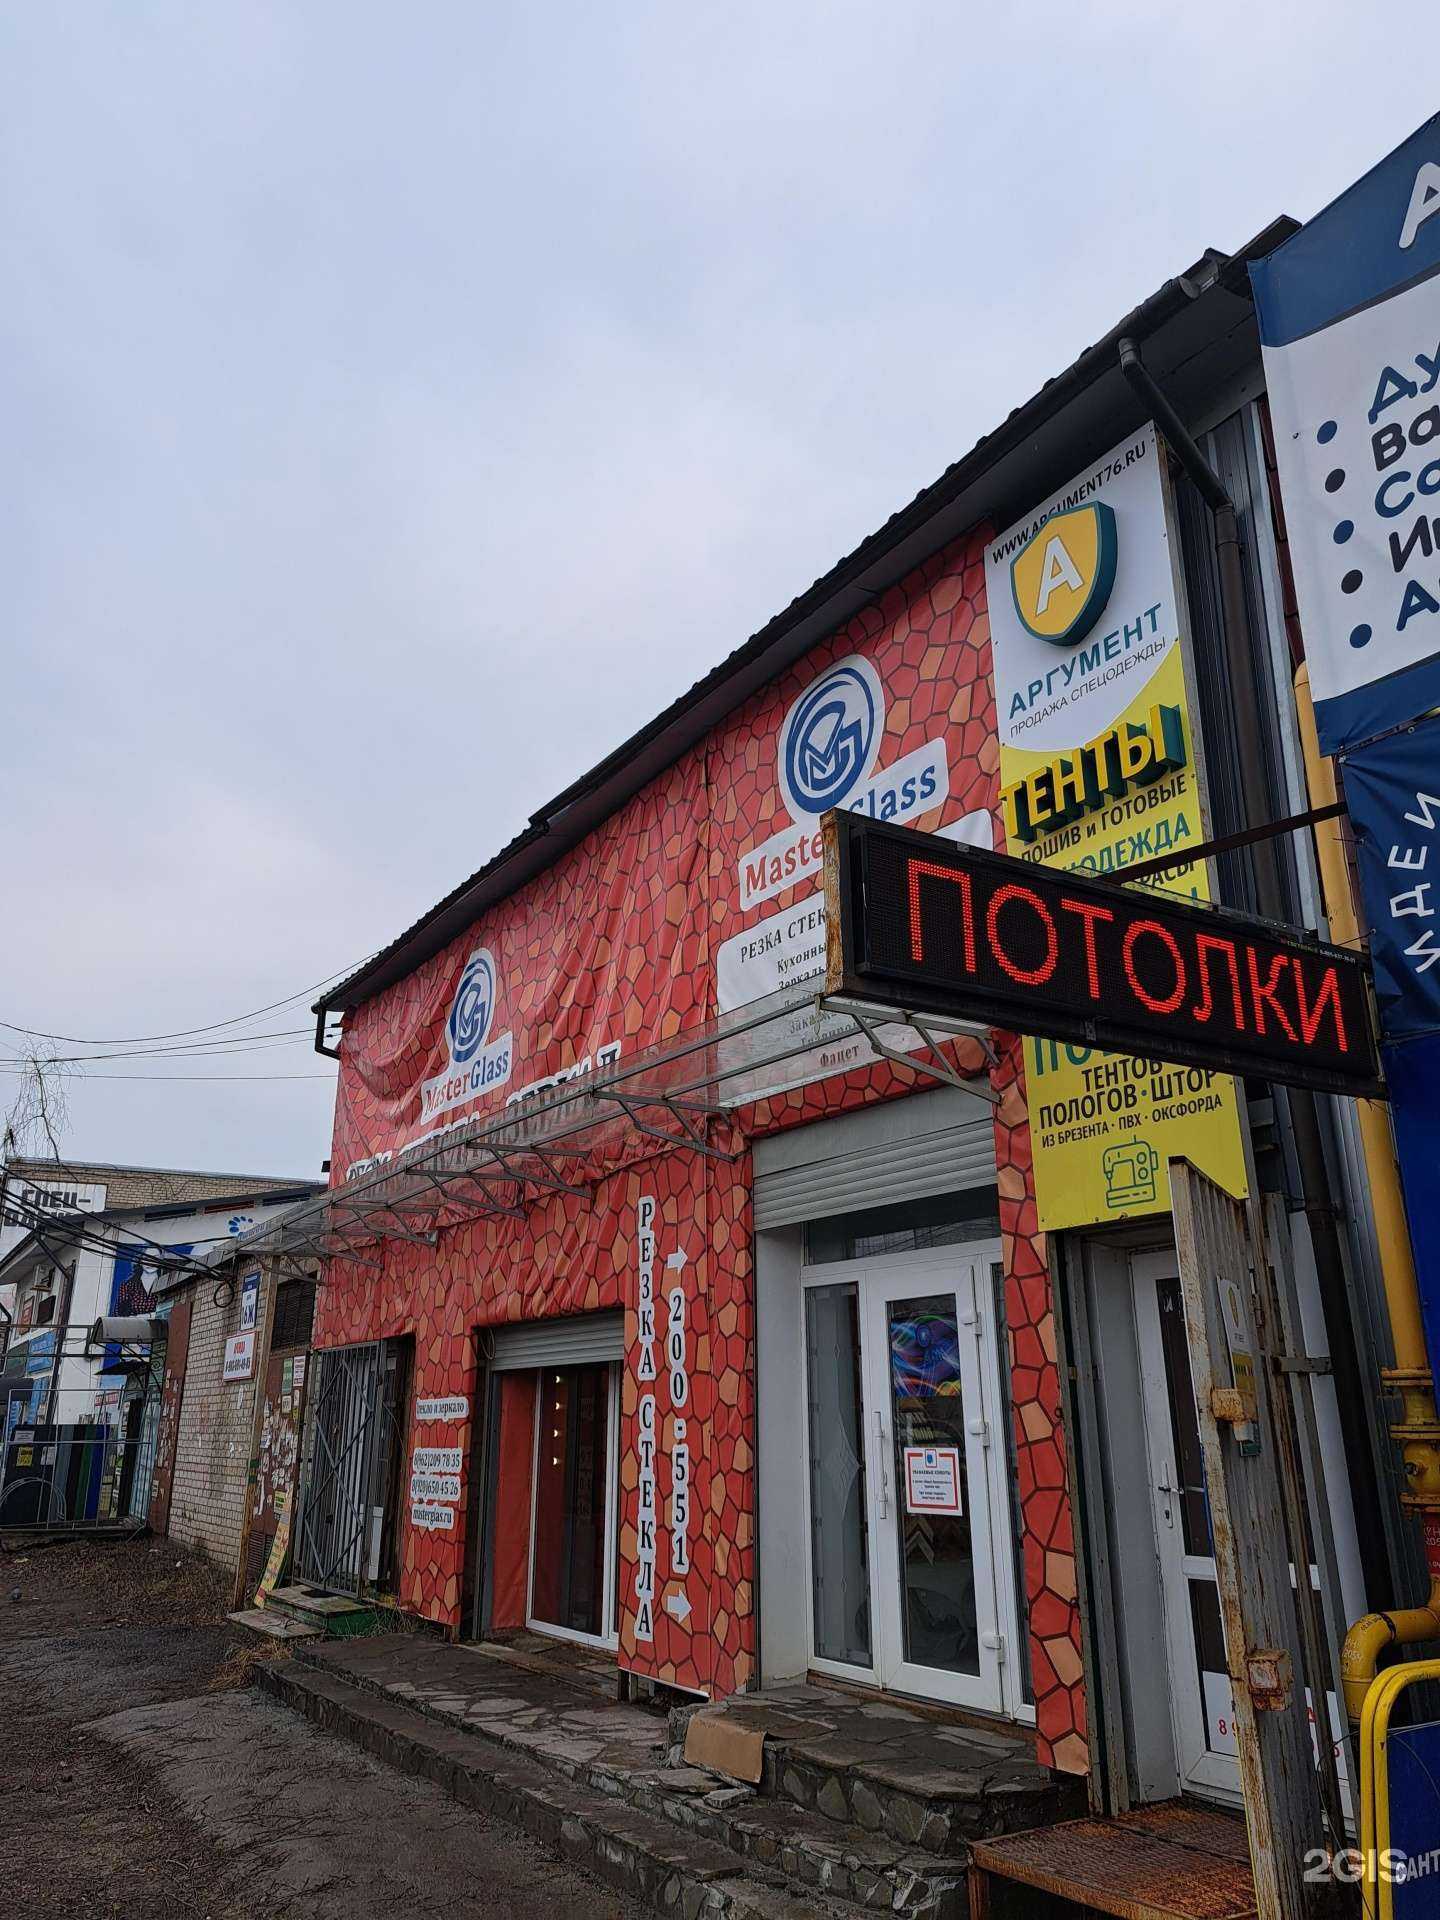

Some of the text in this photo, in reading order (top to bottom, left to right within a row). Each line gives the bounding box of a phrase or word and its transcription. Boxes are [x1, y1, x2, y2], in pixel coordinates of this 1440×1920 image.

[1009, 602, 1162, 719] АРГУМЕНТ
[1010, 636, 1167, 738] ПРОДАЖА СПЕЦОДЕЖДЫ
[998, 704, 1174, 841] ТЕНТЫ
[1102, 774, 1187, 831] ГОТОВЫЕ
[1063, 812, 1191, 878] ОДЕЖДА
[740, 908, 827, 963] РЕЗКА СТЕК
[777, 942, 827, 974] Кухонны
[907, 858, 1348, 1052] ПОТОЛКИ
[1039, 1068, 1216, 1129] ПОЛОГОВ ШТОР
[1082, 1057, 1163, 1092] ТЕНТОВ
[1042, 1094, 1223, 1148] ИЗ БРЕЗЕНТА ПВХ ОКСФОРДА
[638, 1202, 654, 1633] РЕЗКА СТЕКЛА
